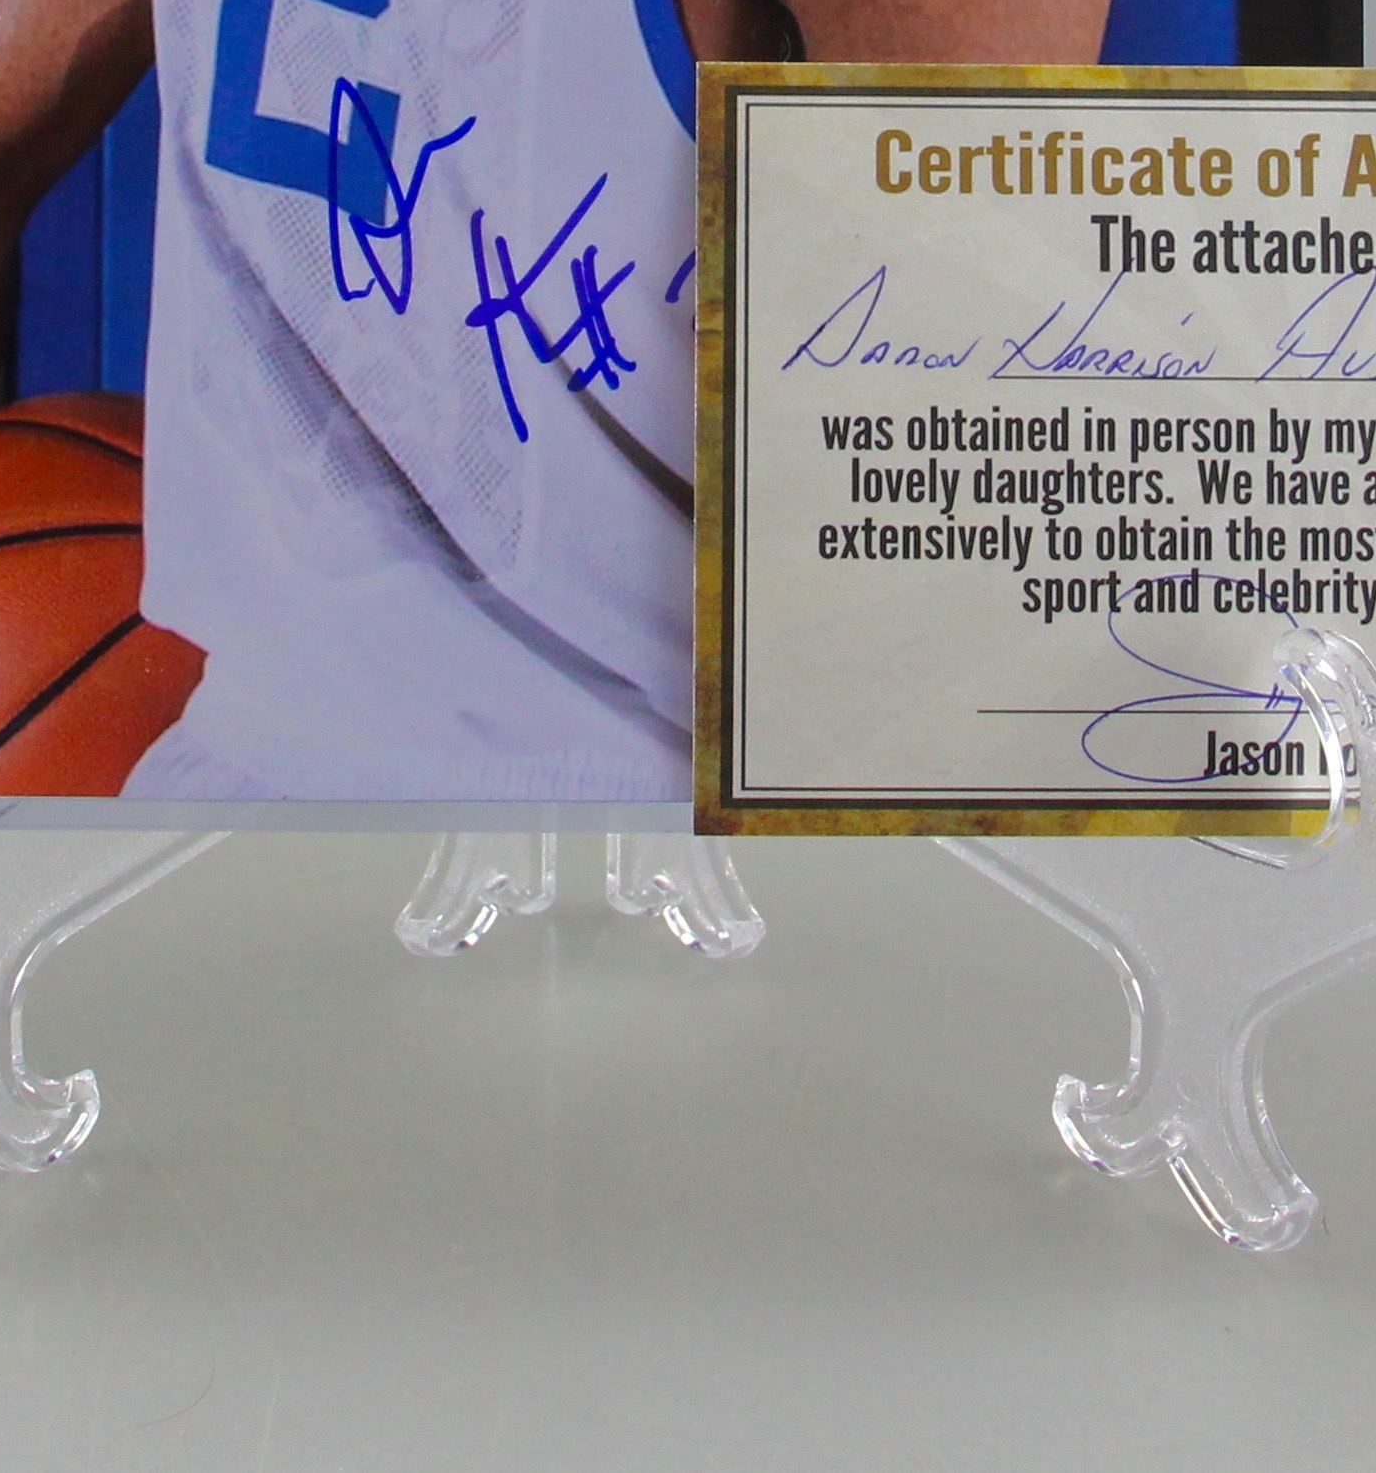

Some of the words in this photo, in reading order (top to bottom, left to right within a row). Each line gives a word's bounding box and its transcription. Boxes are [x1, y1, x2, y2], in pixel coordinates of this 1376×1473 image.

[875, 128, 1233, 197] Certificate
[1256, 133, 1322, 198] of
[1090, 214, 1176, 274] The
[821, 415, 894, 452] was
[906, 405, 1070, 453] obtained
[1083, 405, 1117, 453] in
[1130, 416, 1256, 464] person
[1269, 407, 1312, 466] by
[850, 457, 961, 515] lovely
[972, 458, 1175, 516] daughters.
[1197, 458, 1253, 506] We
[1265, 459, 1351, 506] have
[817, 514, 1034, 572] extensively
[1043, 518, 1084, 562] to
[1095, 515, 1214, 562] obtain
[1225, 516, 1287, 562] the
[1021, 571, 1122, 625] sport
[1132, 567, 1201, 614] and
[1203, 730, 1305, 777] Jason
